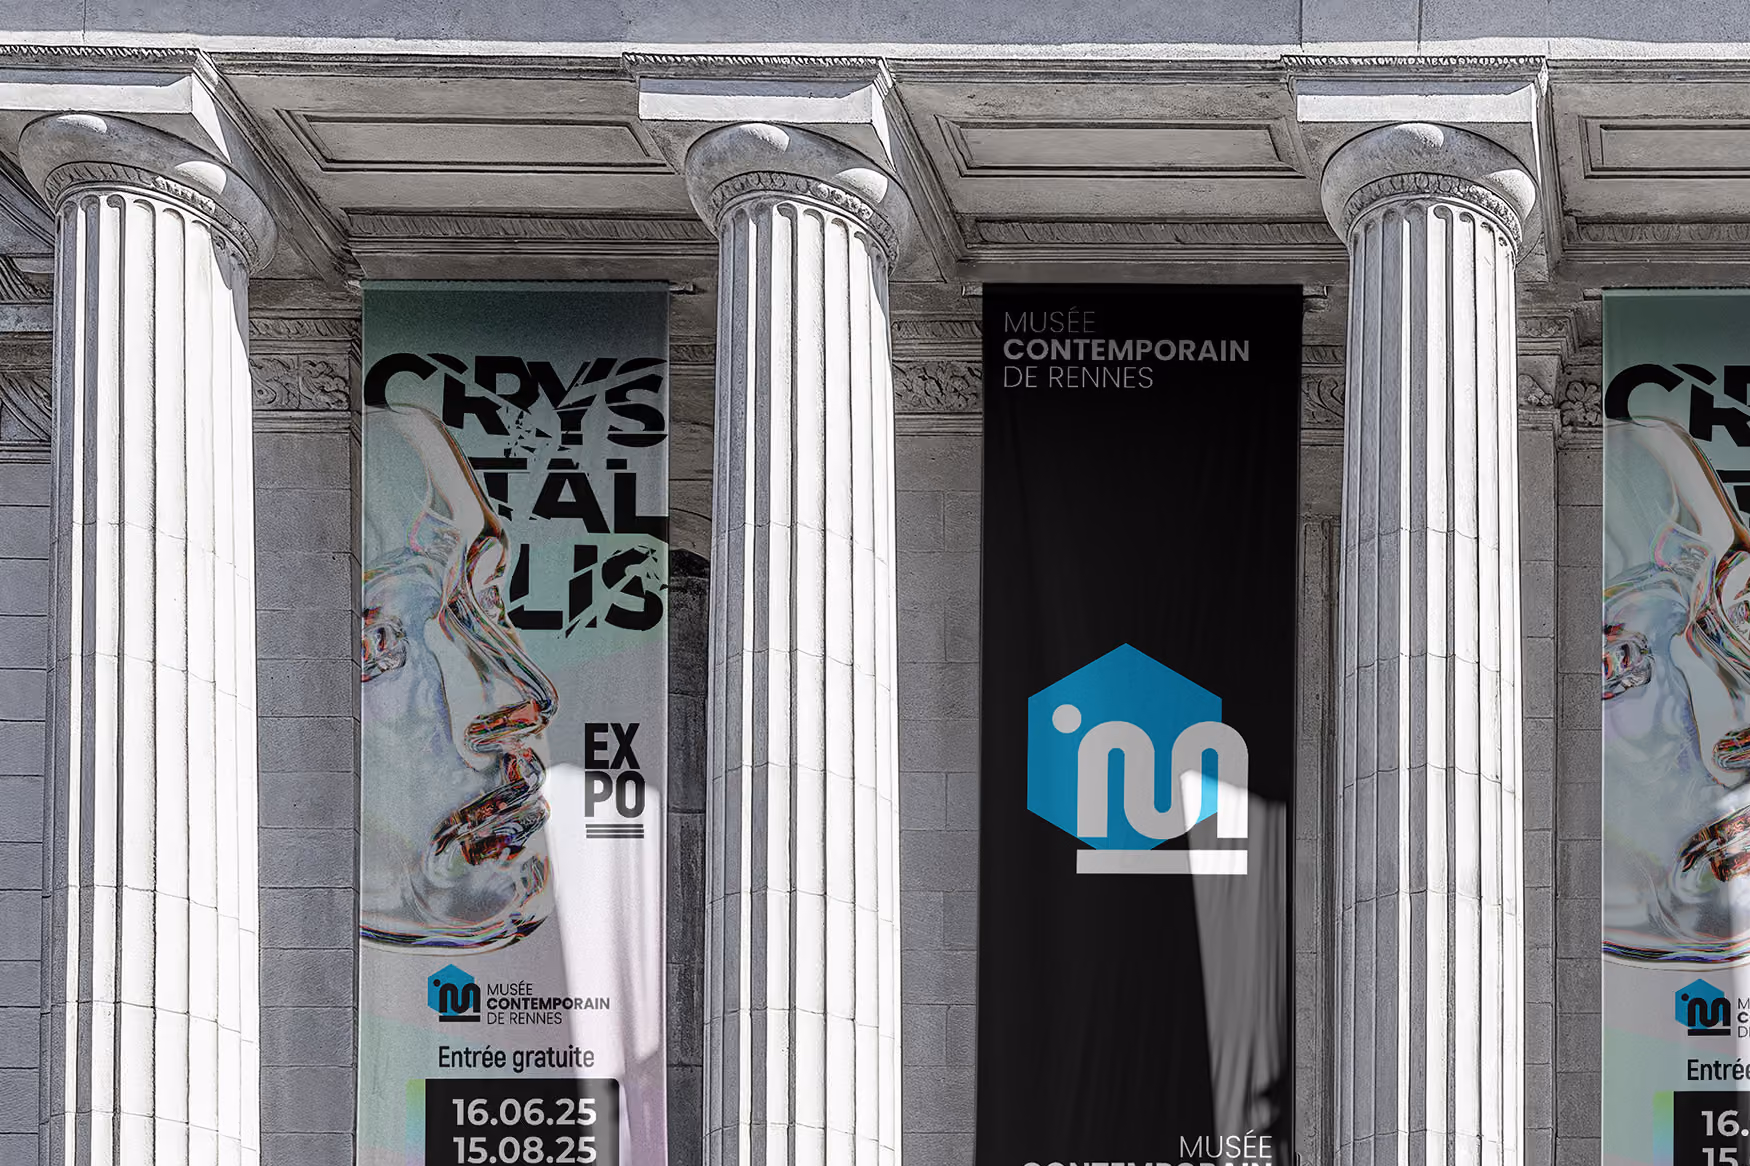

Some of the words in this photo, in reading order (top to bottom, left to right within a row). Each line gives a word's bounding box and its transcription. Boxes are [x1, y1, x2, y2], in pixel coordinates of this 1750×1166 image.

[1004, 306, 1097, 333] MUSÉE
[1003, 338, 1249, 362] CONTEMPORAIN
[1004, 366, 1038, 388] DE
[1049, 366, 1154, 389] RENNES
[468, 457, 669, 542] TAL
[508, 543, 666, 634] LIS
[584, 722, 640, 769] EX
[584, 770, 646, 818] PO
[487, 980, 533, 995] MUSÉE
[487, 997, 611, 1010] CONTEMPORAIN
[487, 1012, 506, 1025] DE
[509, 1012, 562, 1025] RENNES
[438, 1045, 507, 1068] Entrée
[512, 1044, 595, 1073] gratuite
[452, 1098, 597, 1126] 16.06.25
[452, 1136, 597, 1164] 15.08.25
[1179, 1130, 1273, 1159] MUSÉE
